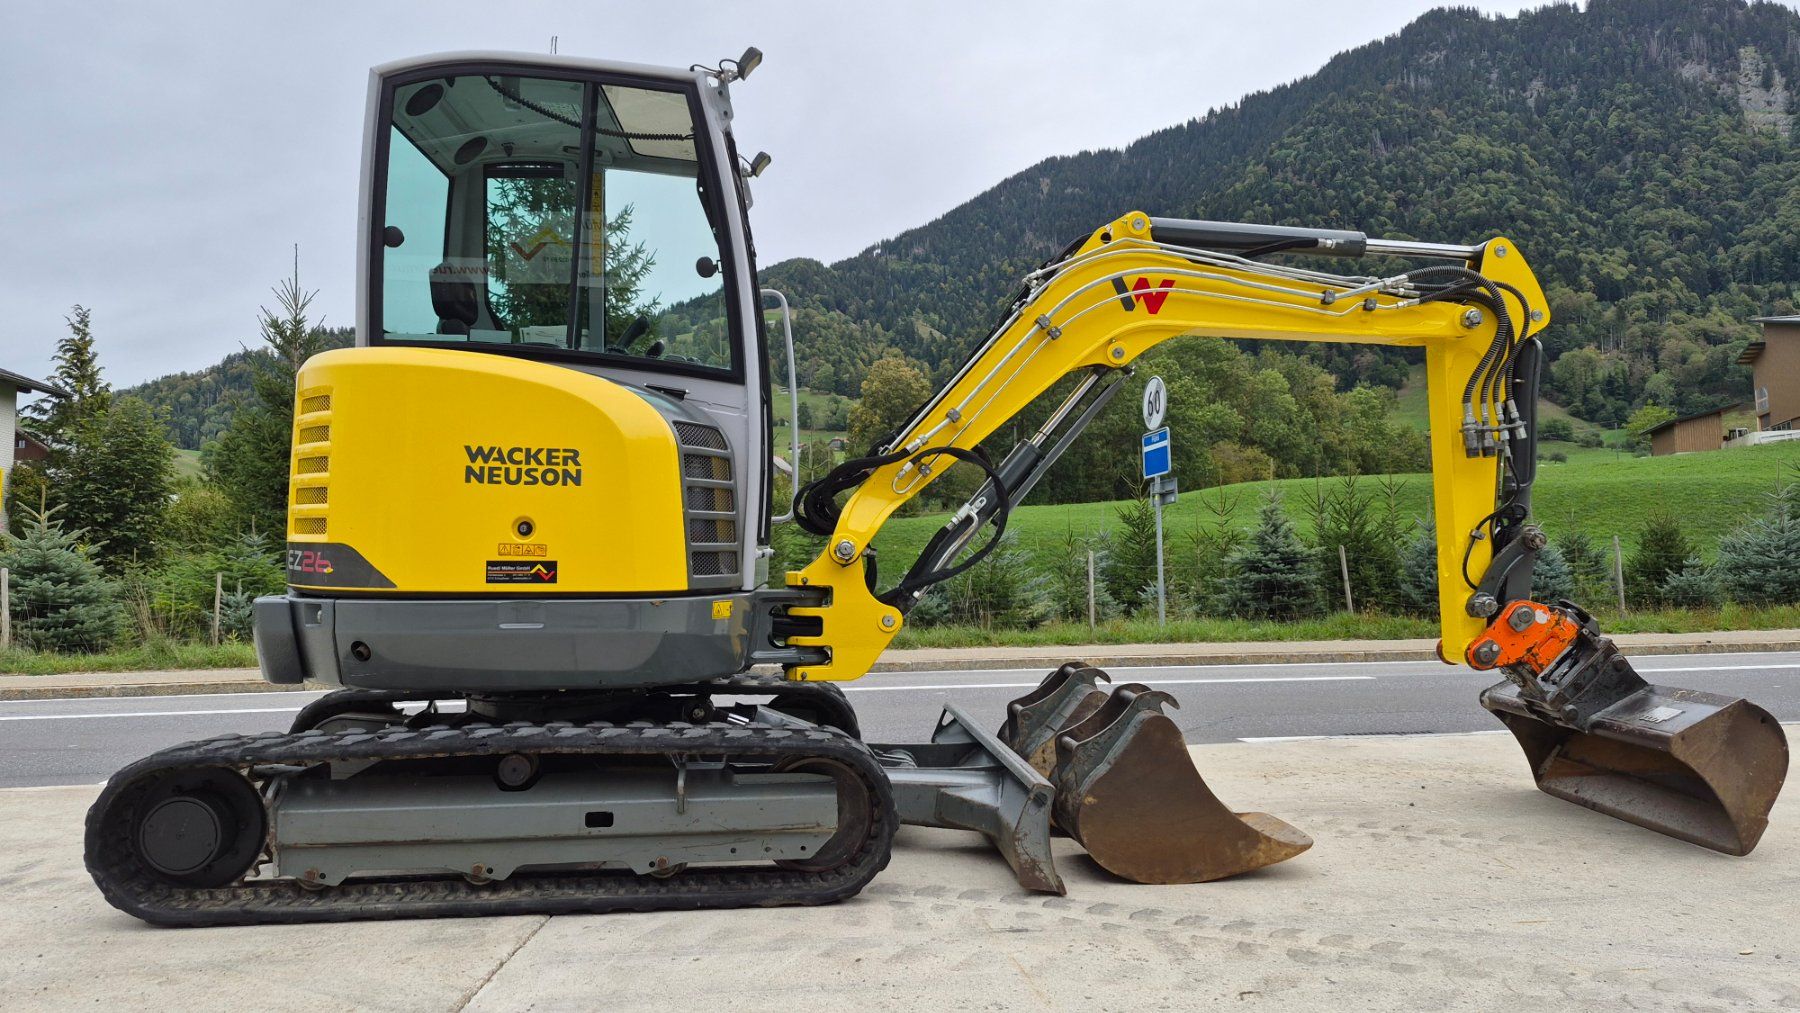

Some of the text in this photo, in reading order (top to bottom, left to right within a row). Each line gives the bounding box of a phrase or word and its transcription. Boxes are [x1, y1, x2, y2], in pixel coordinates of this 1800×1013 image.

[1147, 391, 1160, 417] 60
[464, 445, 582, 467] WACKER
[464, 465, 582, 487] NEUSON
[288, 549, 332, 573] EZ26
